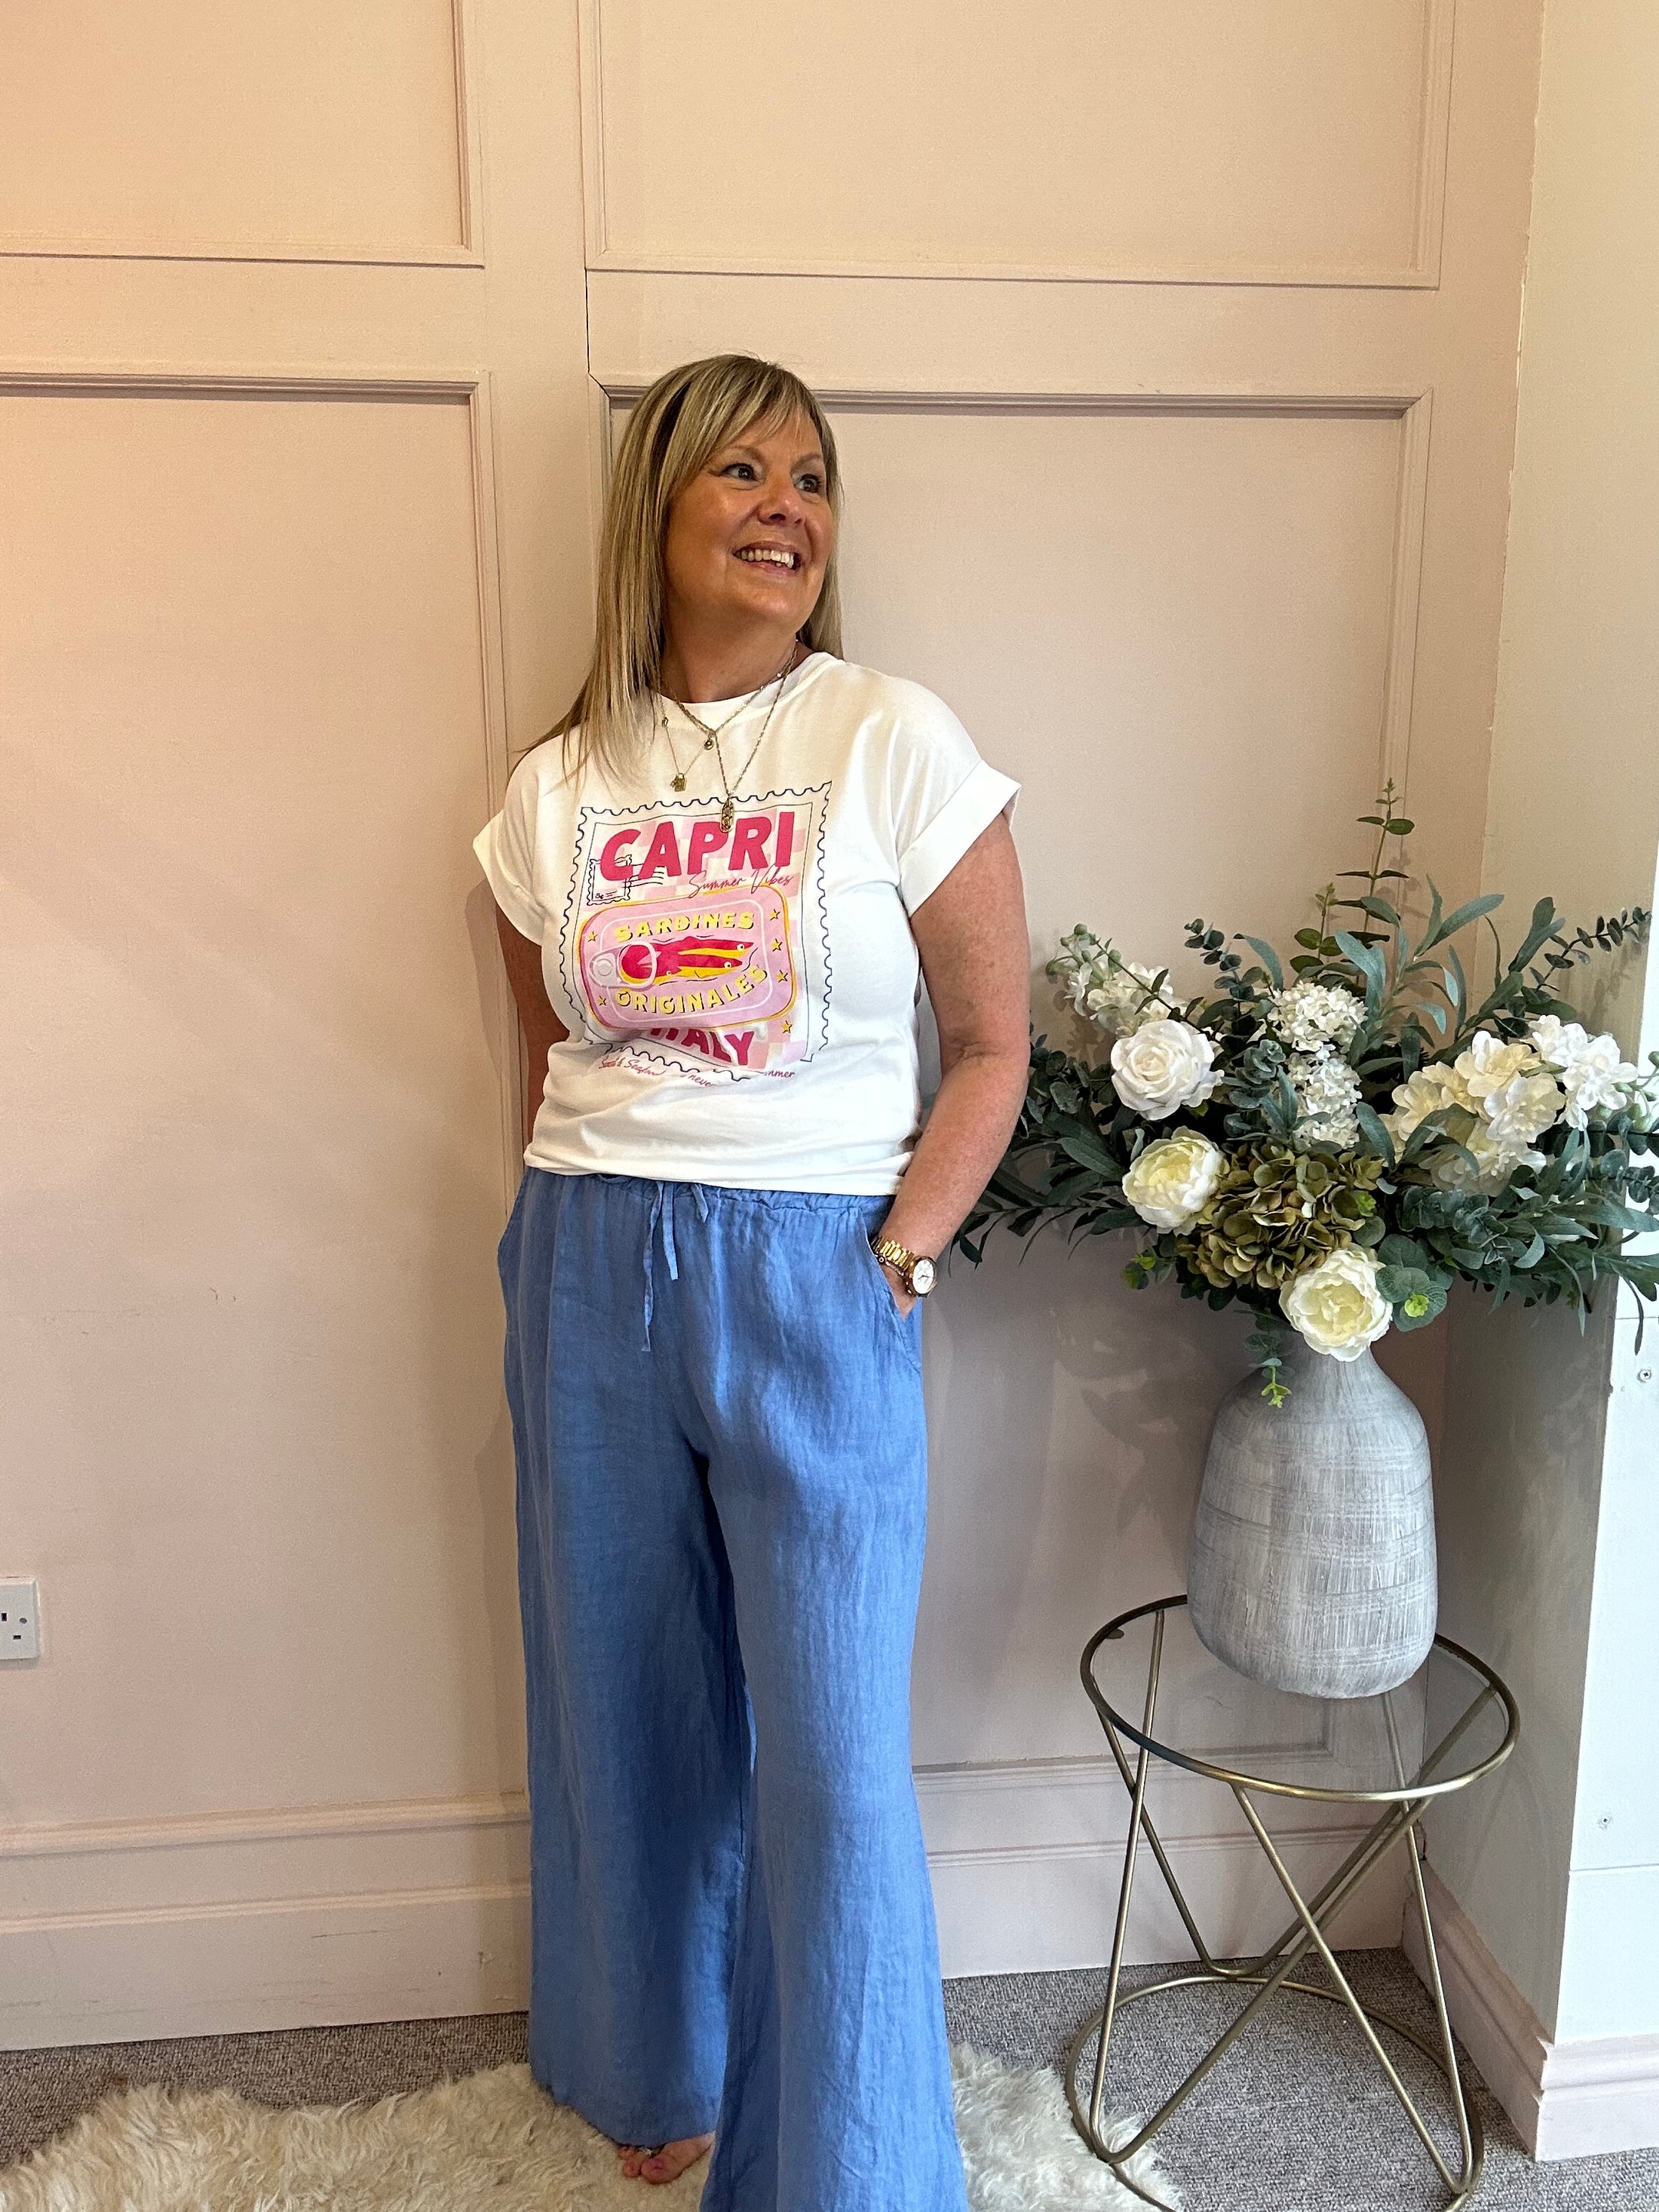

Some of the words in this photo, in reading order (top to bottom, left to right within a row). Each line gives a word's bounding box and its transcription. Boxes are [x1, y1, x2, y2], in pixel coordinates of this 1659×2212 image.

[600, 811, 795, 881] CAPRI
[688, 870, 747, 898] Summer
[750, 864, 794, 894] Vibes
[615, 910, 755, 943] SARDINES
[615, 964, 768, 1014] ORIGINALES
